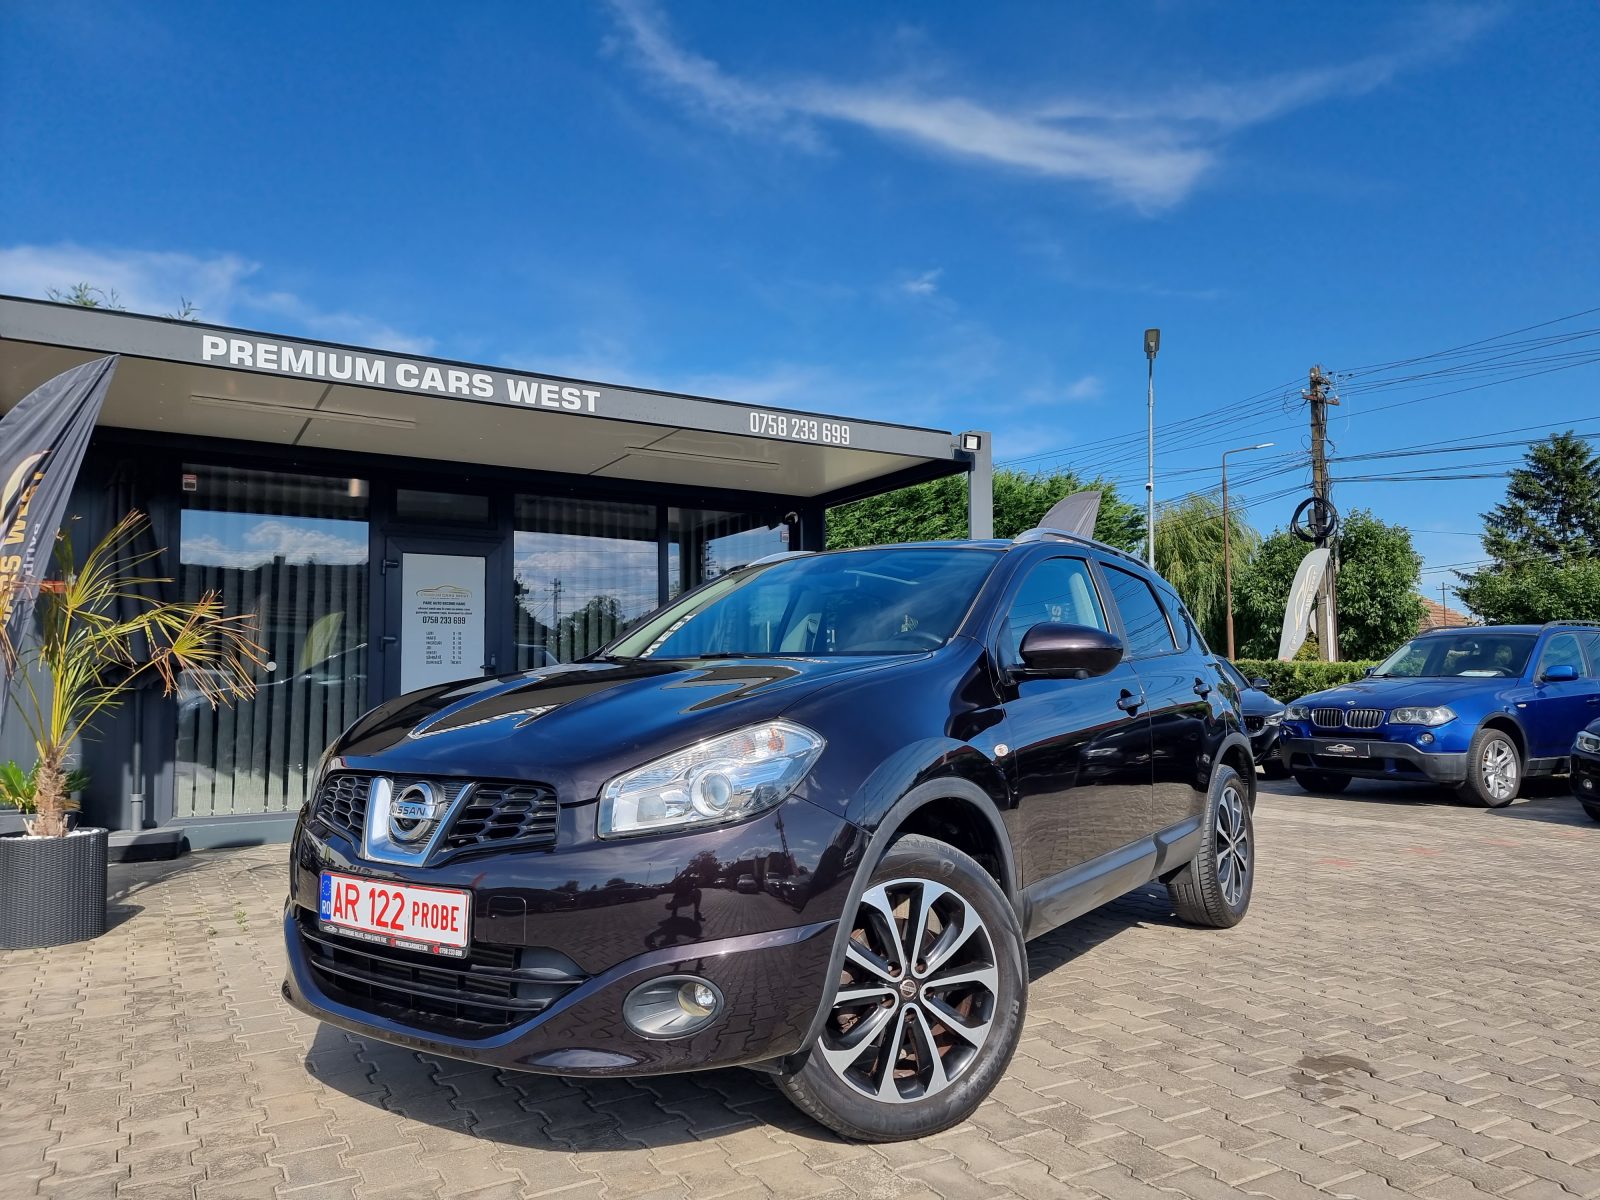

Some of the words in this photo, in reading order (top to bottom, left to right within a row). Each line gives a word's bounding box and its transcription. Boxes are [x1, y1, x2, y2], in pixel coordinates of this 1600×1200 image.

[202, 335, 386, 385] PREMIUM
[395, 363, 494, 398] CARS
[506, 378, 601, 413] WEST
[749, 412, 788, 437] 0758
[791, 418, 818, 441] 233
[822, 422, 850, 445] 699
[422, 616, 438, 624] 0758
[440, 616, 452, 624] 233
[453, 617, 466, 625] 699
[390, 804, 426, 816] NISSAN
[322, 900, 331, 914] RO
[333, 882, 360, 922] AR
[369, 887, 406, 931] 122
[412, 901, 460, 932] PROBE
